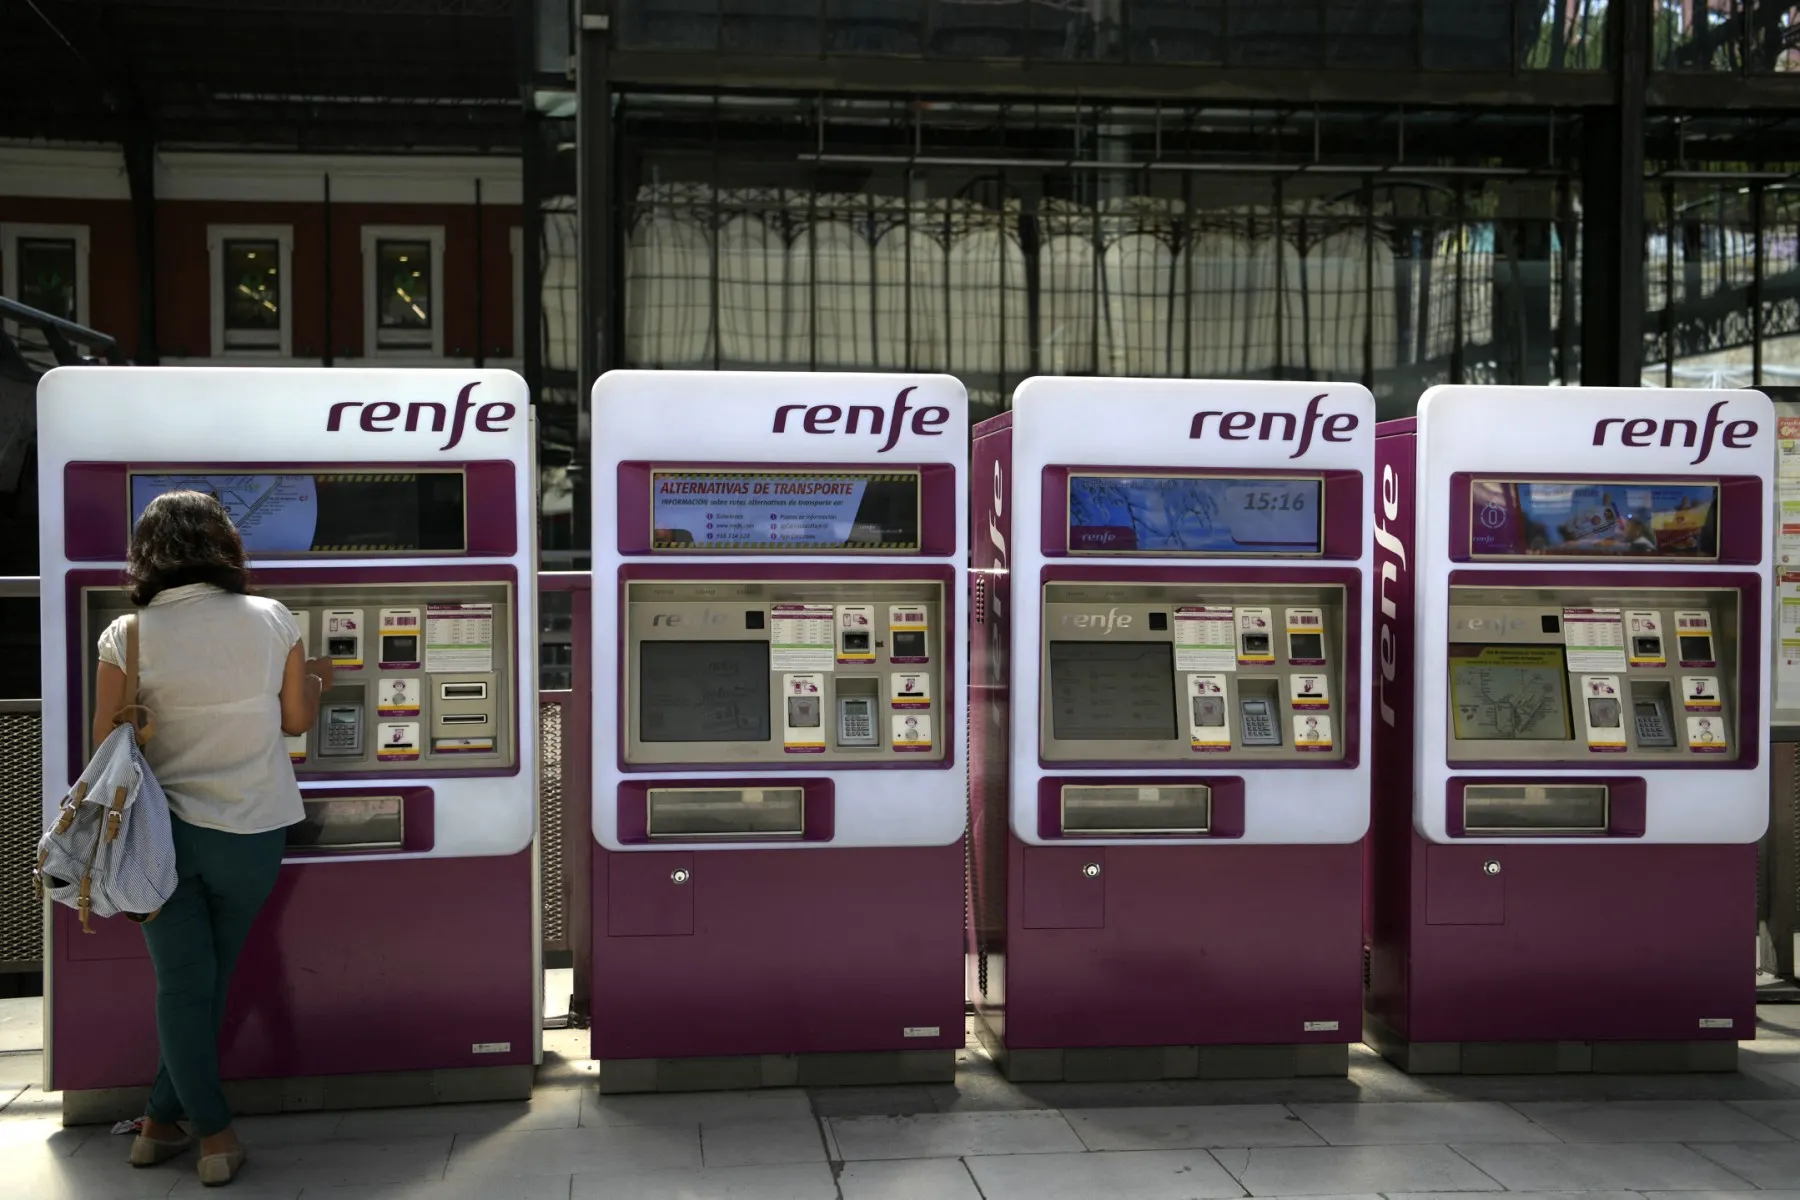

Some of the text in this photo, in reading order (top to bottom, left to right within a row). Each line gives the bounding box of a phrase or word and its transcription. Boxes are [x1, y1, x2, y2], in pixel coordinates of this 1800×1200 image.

[327, 382, 515, 451] renfe
[773, 386, 949, 452] renfe
[1190, 394, 1358, 458] renfe
[1593, 401, 1758, 465] renfe
[660, 482, 854, 495] ALTERNATIVAS DE TRANSPORTE
[1243, 492, 1305, 511] 15:16
[1082, 529, 1116, 544] renfe
[652, 608, 728, 630] refe
[1373, 463, 1407, 728] renfe
